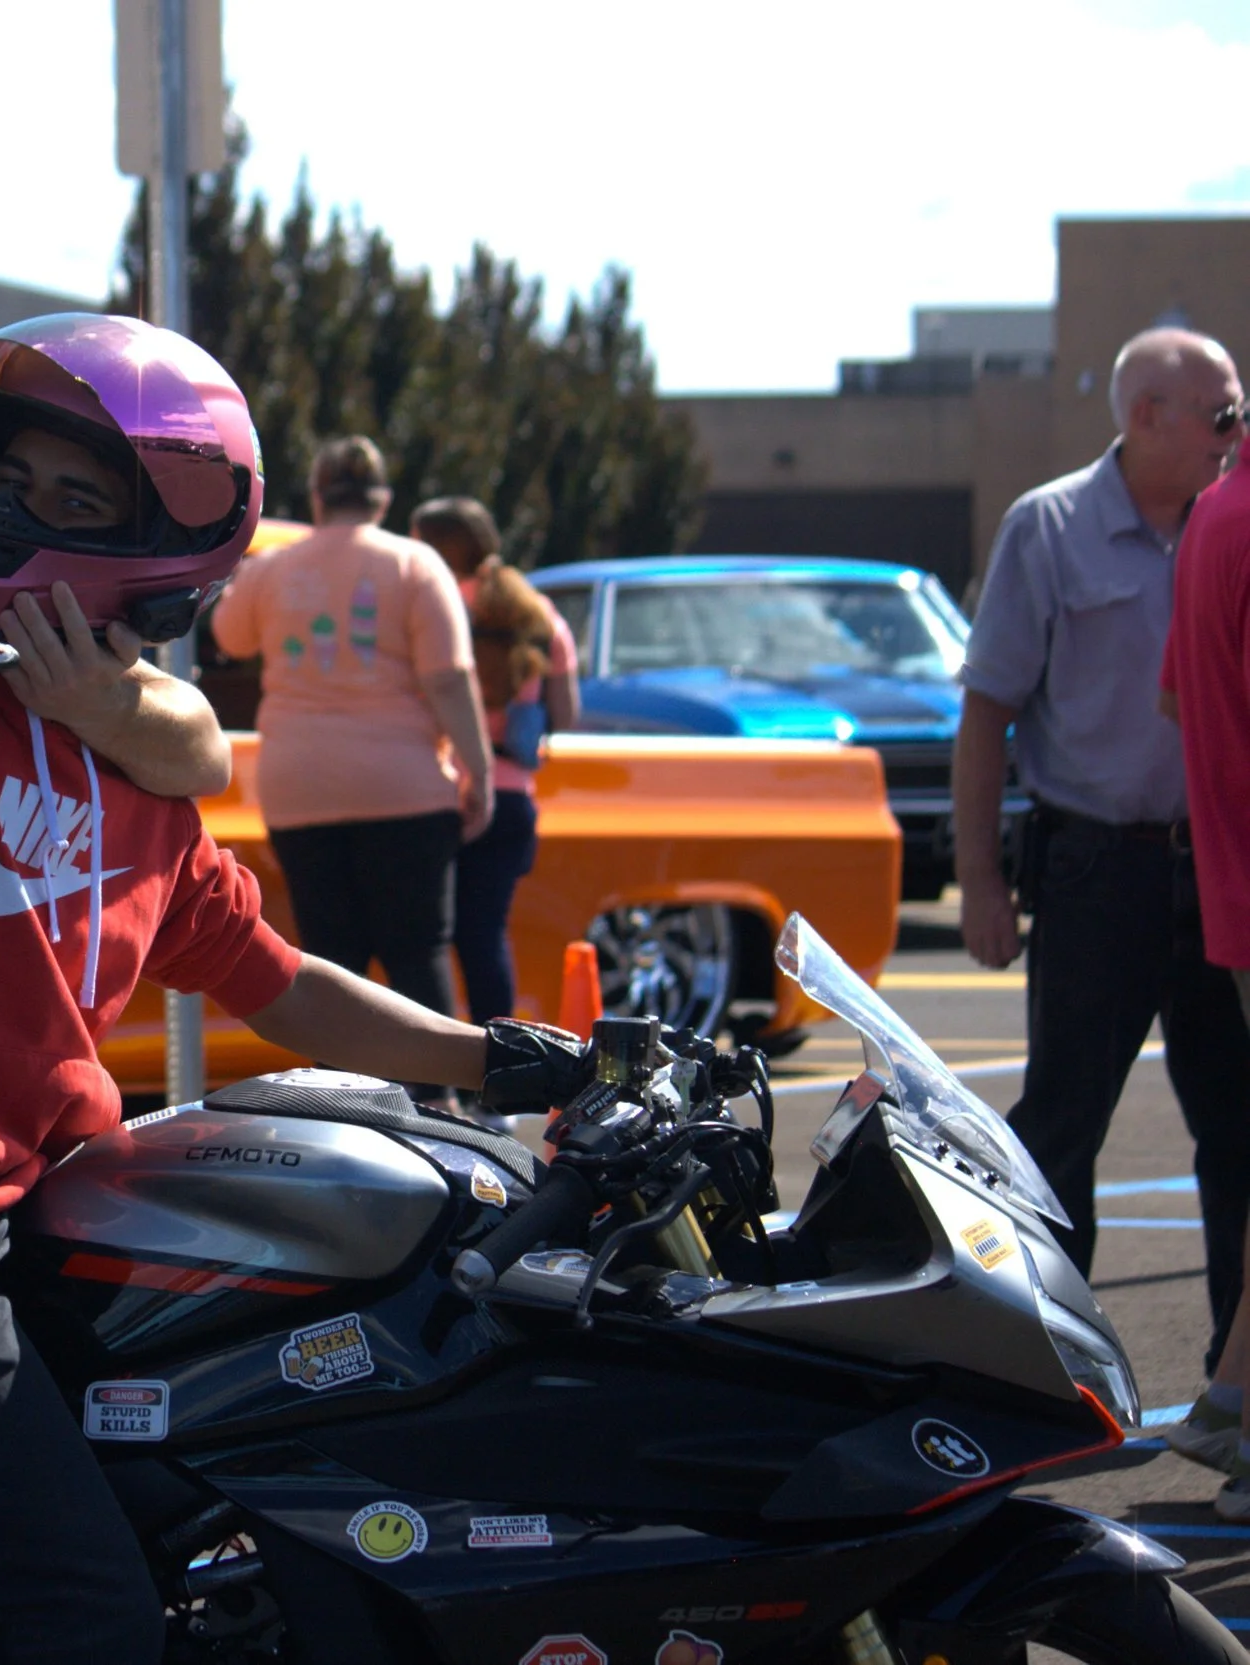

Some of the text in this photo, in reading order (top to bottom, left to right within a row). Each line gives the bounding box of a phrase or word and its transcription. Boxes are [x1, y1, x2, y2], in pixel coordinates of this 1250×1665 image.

[185, 1147, 302, 1167] CFMOTO
[296, 1318, 356, 1343] I WONDER IF
[299, 1327, 361, 1360] BEER
[323, 1342, 363, 1361] THINKS
[324, 1352, 366, 1371] ABOUT
[314, 1363, 370, 1385] ME TOO...
[110, 1391, 143, 1401] DANGER
[101, 1407, 151, 1417] STUPID
[100, 1419, 150, 1433] KILLS
[349, 1509, 371, 1533] SMILE
[371, 1504, 381, 1512] IF
[413, 1519, 426, 1549] HORNY
[475, 1525, 536, 1536] ATTITUDE
[504, 1517, 526, 1525] LIKE
[539, 1652, 588, 1665] STOP
